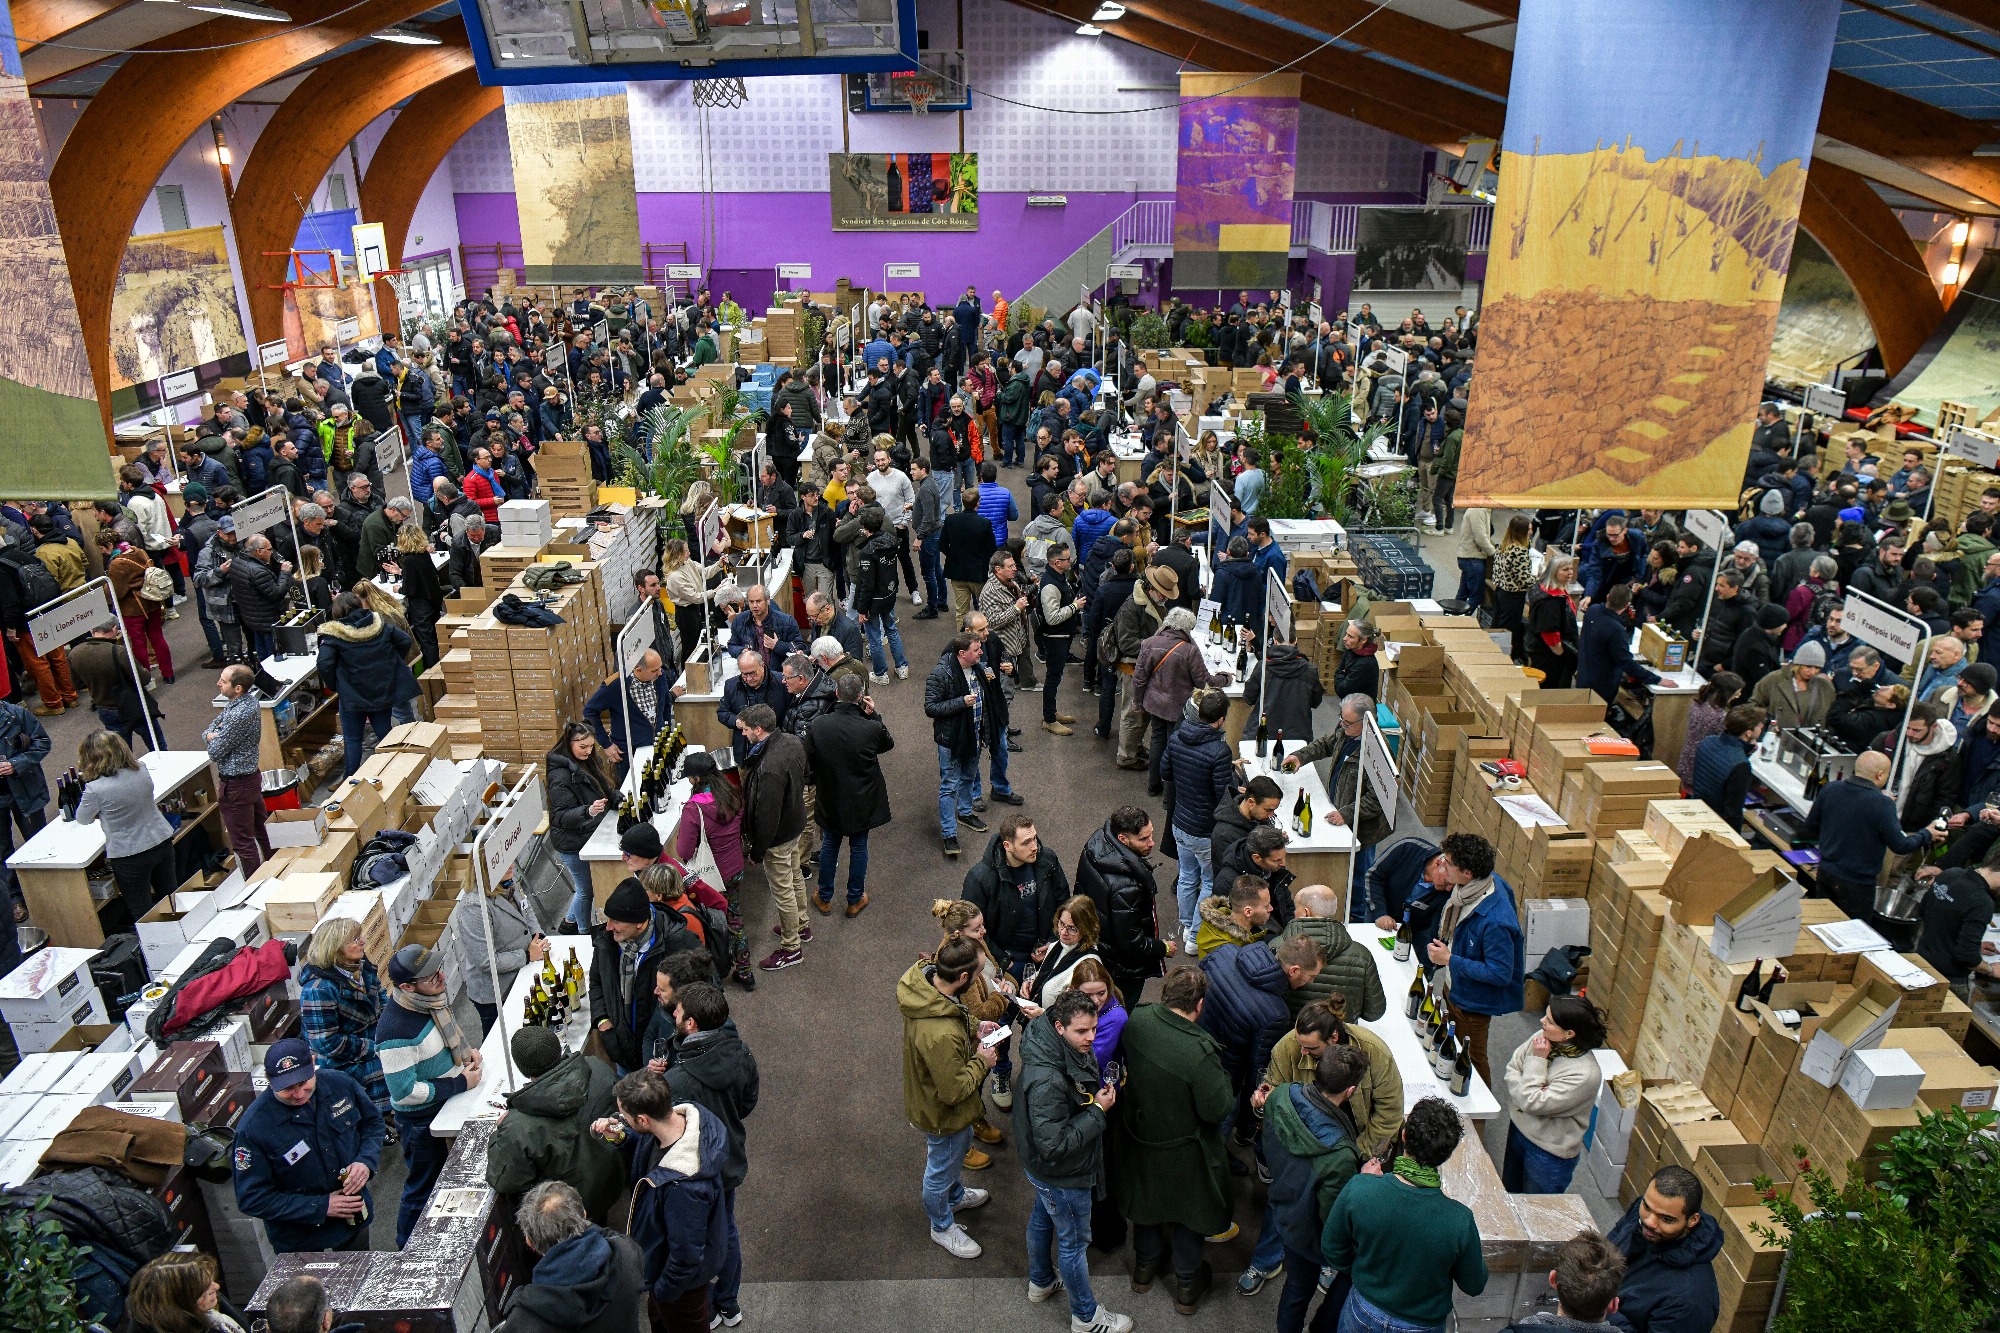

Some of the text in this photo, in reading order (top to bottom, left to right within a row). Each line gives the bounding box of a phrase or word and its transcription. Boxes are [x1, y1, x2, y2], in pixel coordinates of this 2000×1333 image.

[841, 217, 969, 227] Syndicat des vignerons de Côte Rôtie
[238, 521, 245, 530] 37
[37, 608, 94, 642] 36 Lionel Faury
[1846, 610, 1911, 650] 65 François Villard
[490, 820, 522, 870] 50 Guigal
